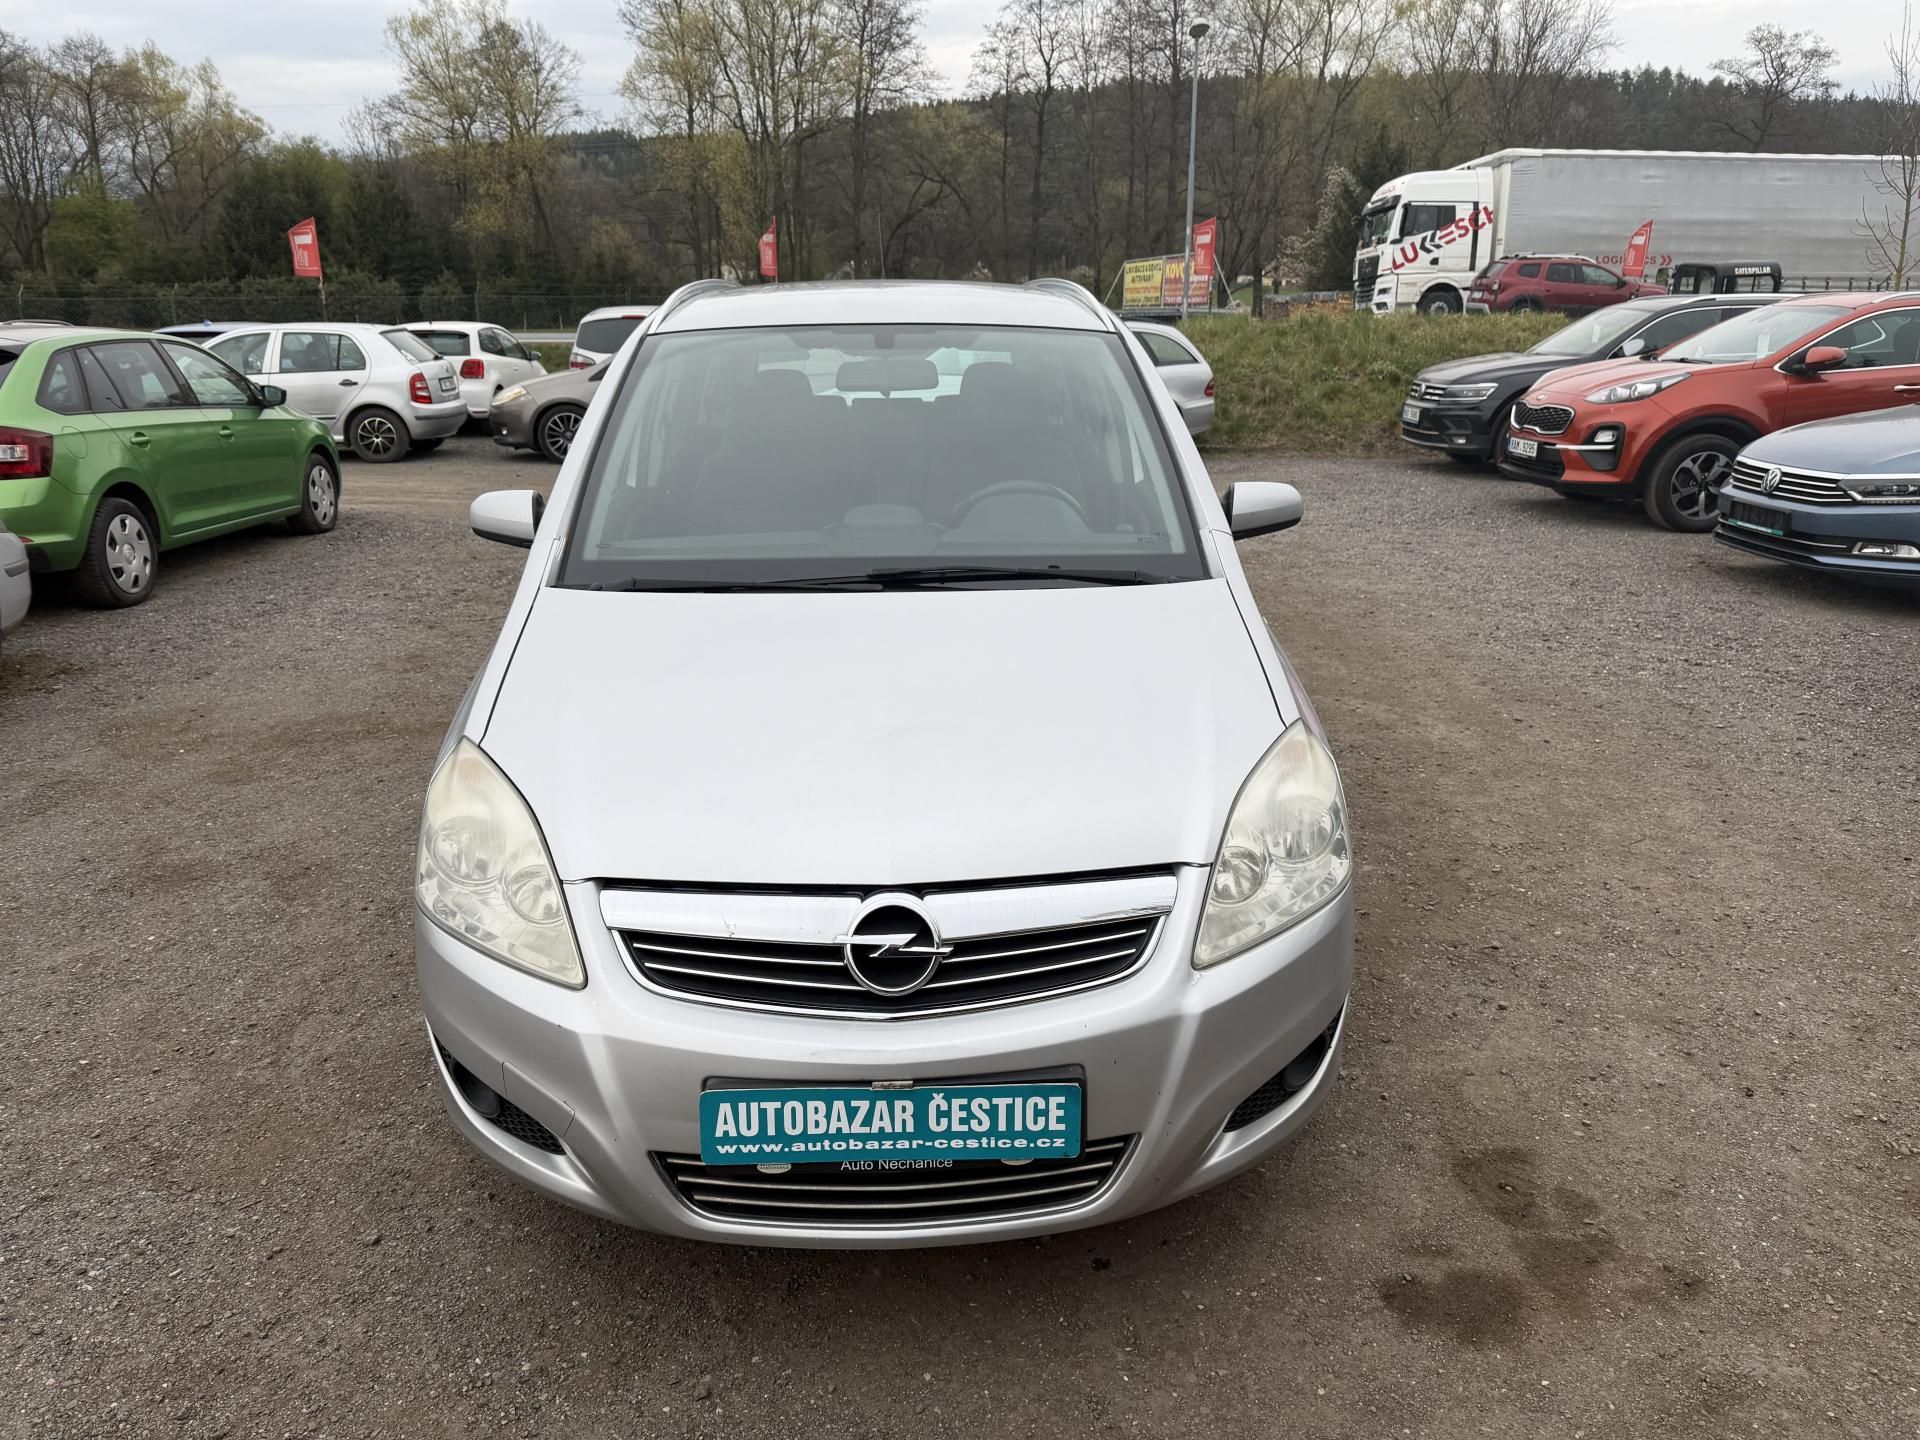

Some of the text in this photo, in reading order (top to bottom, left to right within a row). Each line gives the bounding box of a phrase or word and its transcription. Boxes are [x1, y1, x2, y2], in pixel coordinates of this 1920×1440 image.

[1595, 255, 1657, 265] LOGICS
[715, 1093, 1066, 1138] AUTOBAZAR ČESTICE
[716, 1136, 1065, 1154] www.autobazar-cestice.cz
[840, 1160, 873, 1171] Auto
